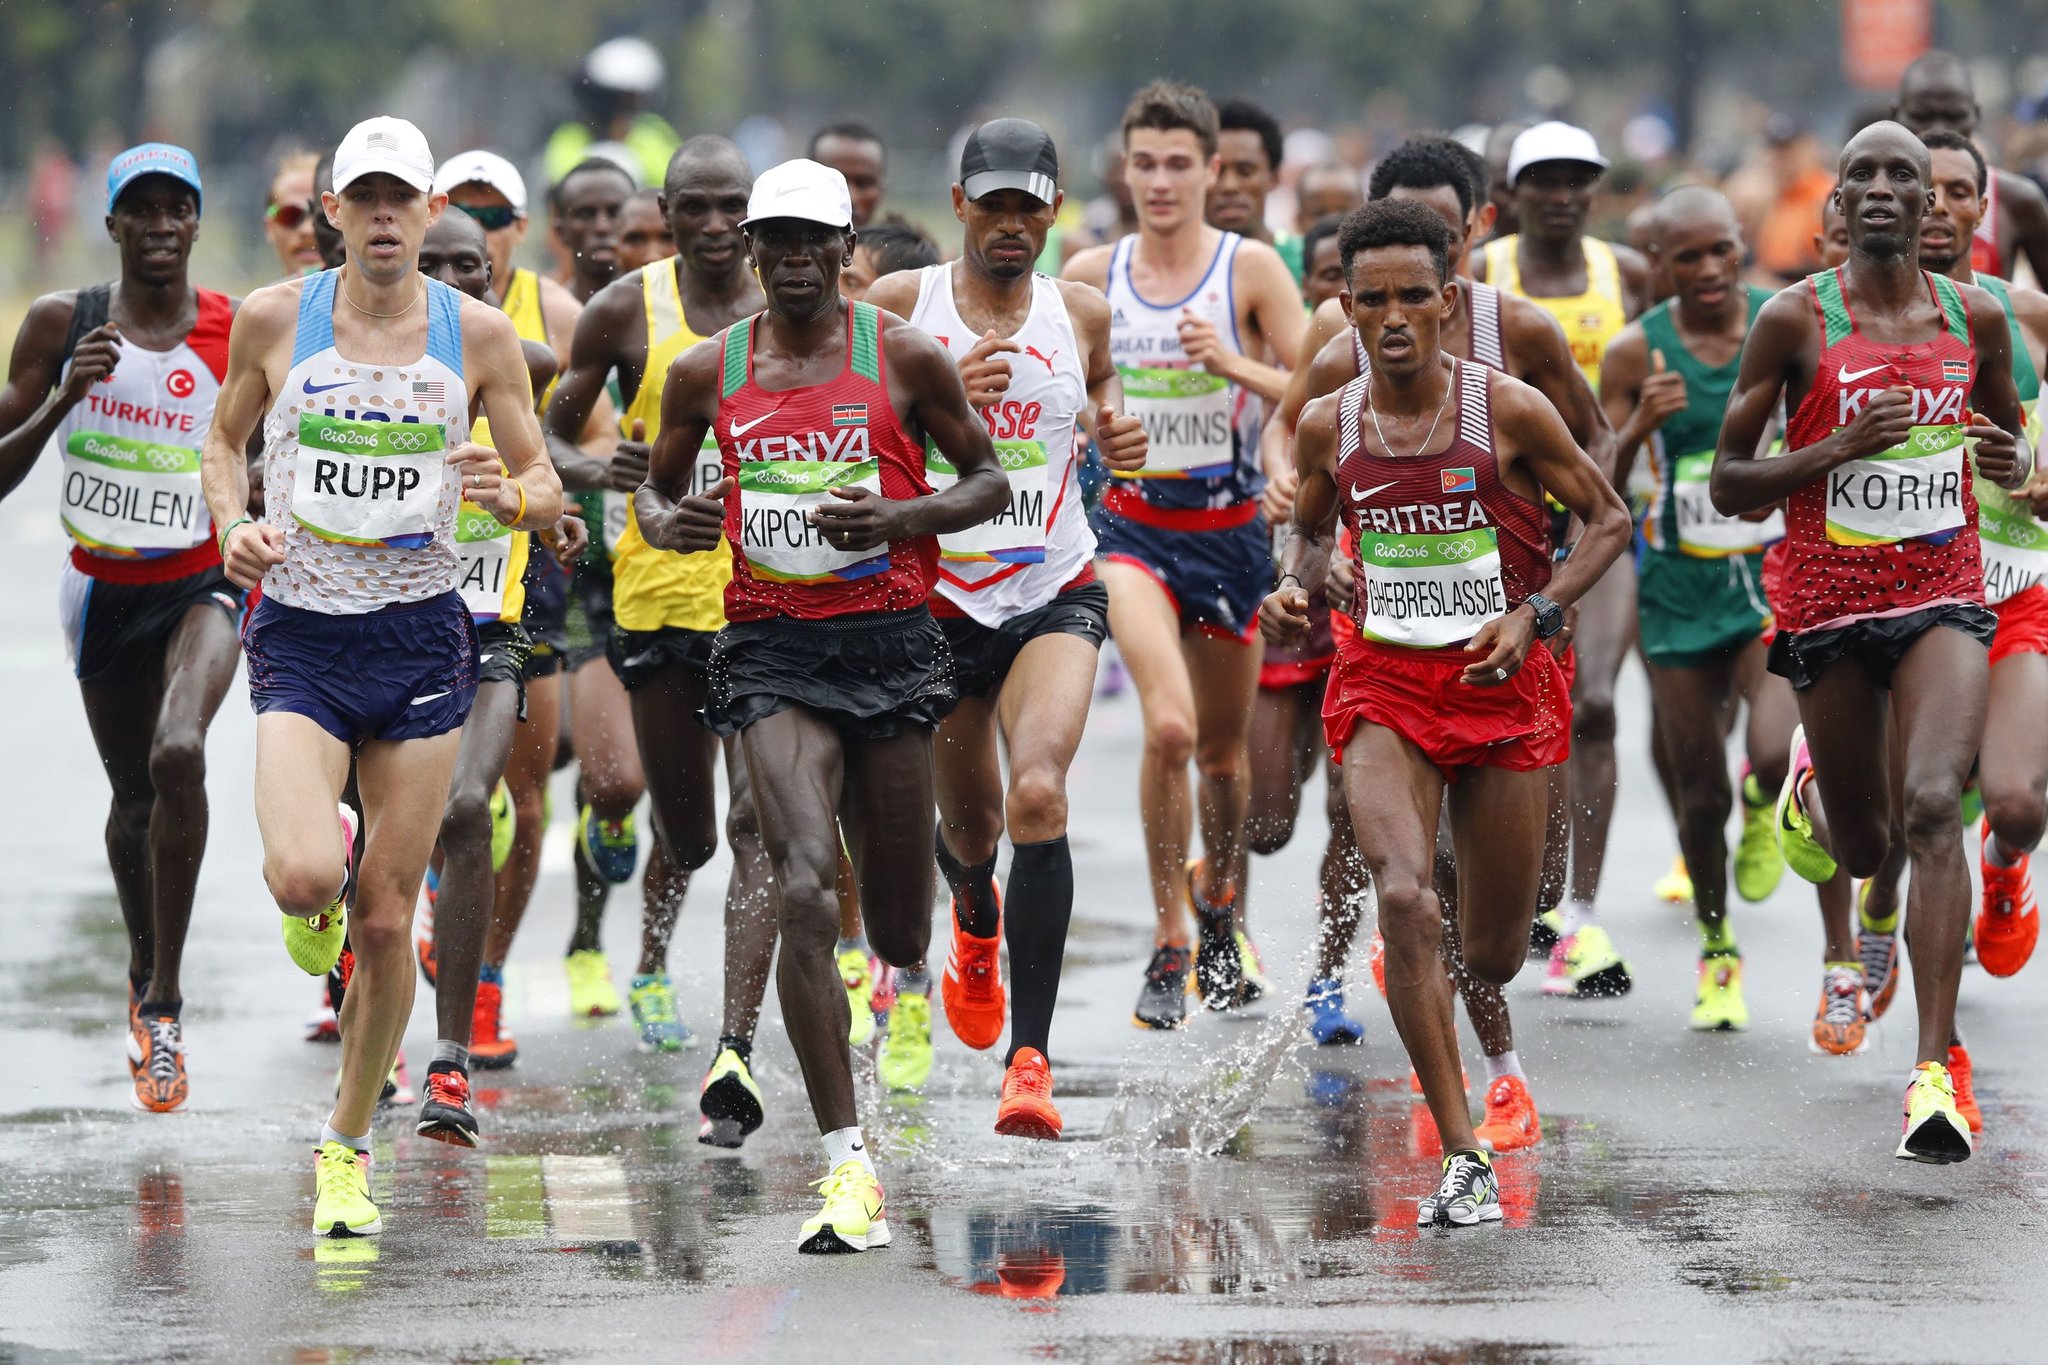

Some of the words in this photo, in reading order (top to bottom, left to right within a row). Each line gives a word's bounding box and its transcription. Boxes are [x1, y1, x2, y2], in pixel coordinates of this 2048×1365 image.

[88, 395, 194, 432] TÜRKİYE
[1839, 387, 1964, 424] KYA
[319, 427, 379, 447] Rio2016
[734, 428, 869, 463] KENYA
[1129, 411, 1228, 447] WKINS
[84, 438, 138, 463] Rio2016
[314, 459, 420, 501] RUPP
[755, 470, 810, 485] Rio2016
[1831, 471, 1959, 511] KORIR
[66, 471, 193, 530] OZBILEN
[1354, 500, 1489, 534] ERITREA
[744, 508, 823, 548] KIPCH
[1374, 542, 1429, 558] Rio2016
[1368, 576, 1504, 620] GHEBRESLASSIE
